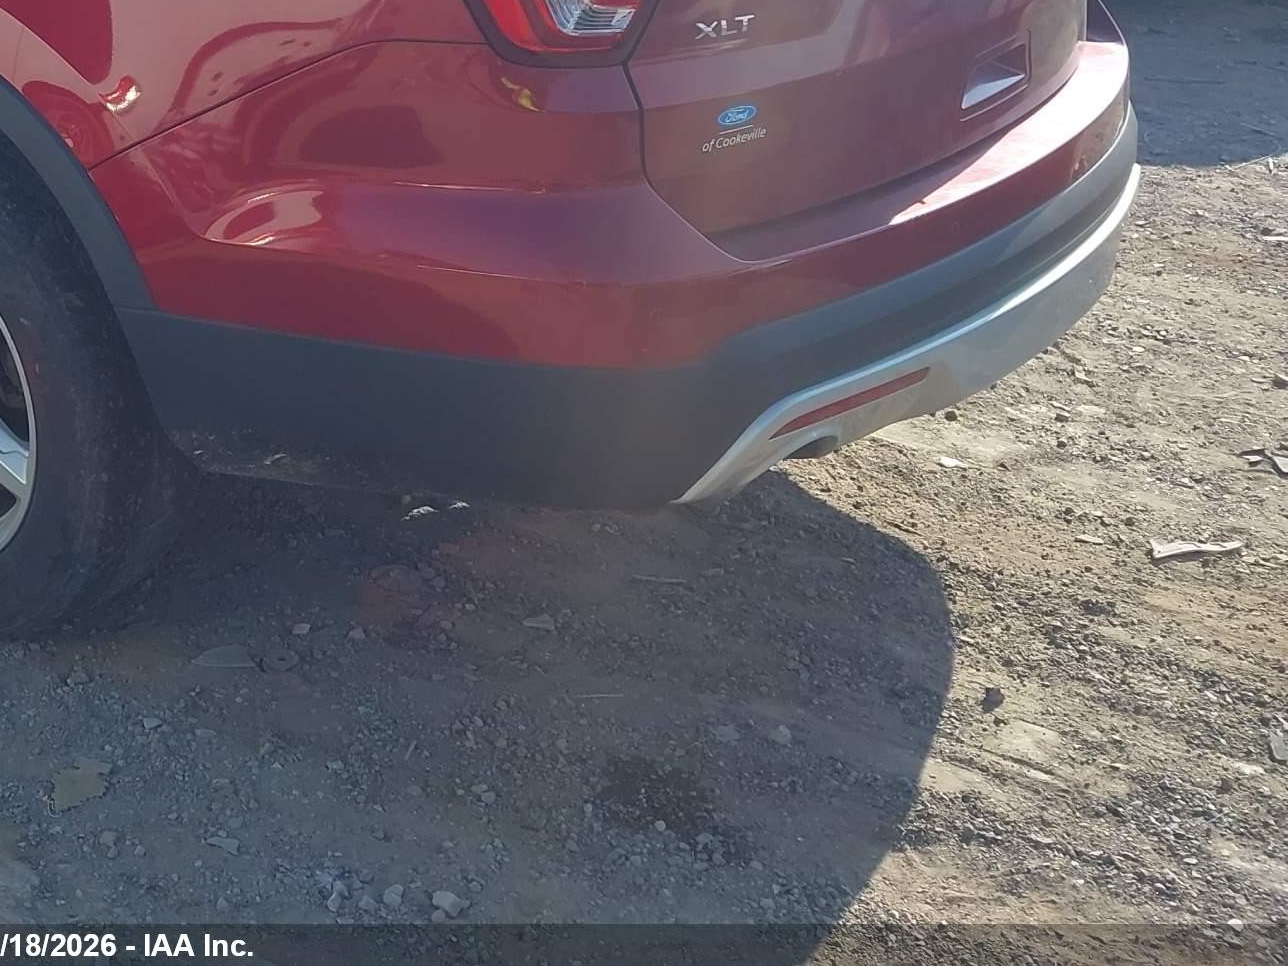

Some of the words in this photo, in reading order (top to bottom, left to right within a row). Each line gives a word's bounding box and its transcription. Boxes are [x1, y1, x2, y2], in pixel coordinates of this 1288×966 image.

[695, 14, 756, 40] XLT
[724, 108, 751, 123] Ford
[702, 139, 716, 153] of
[716, 127, 767, 149] Cookeville
